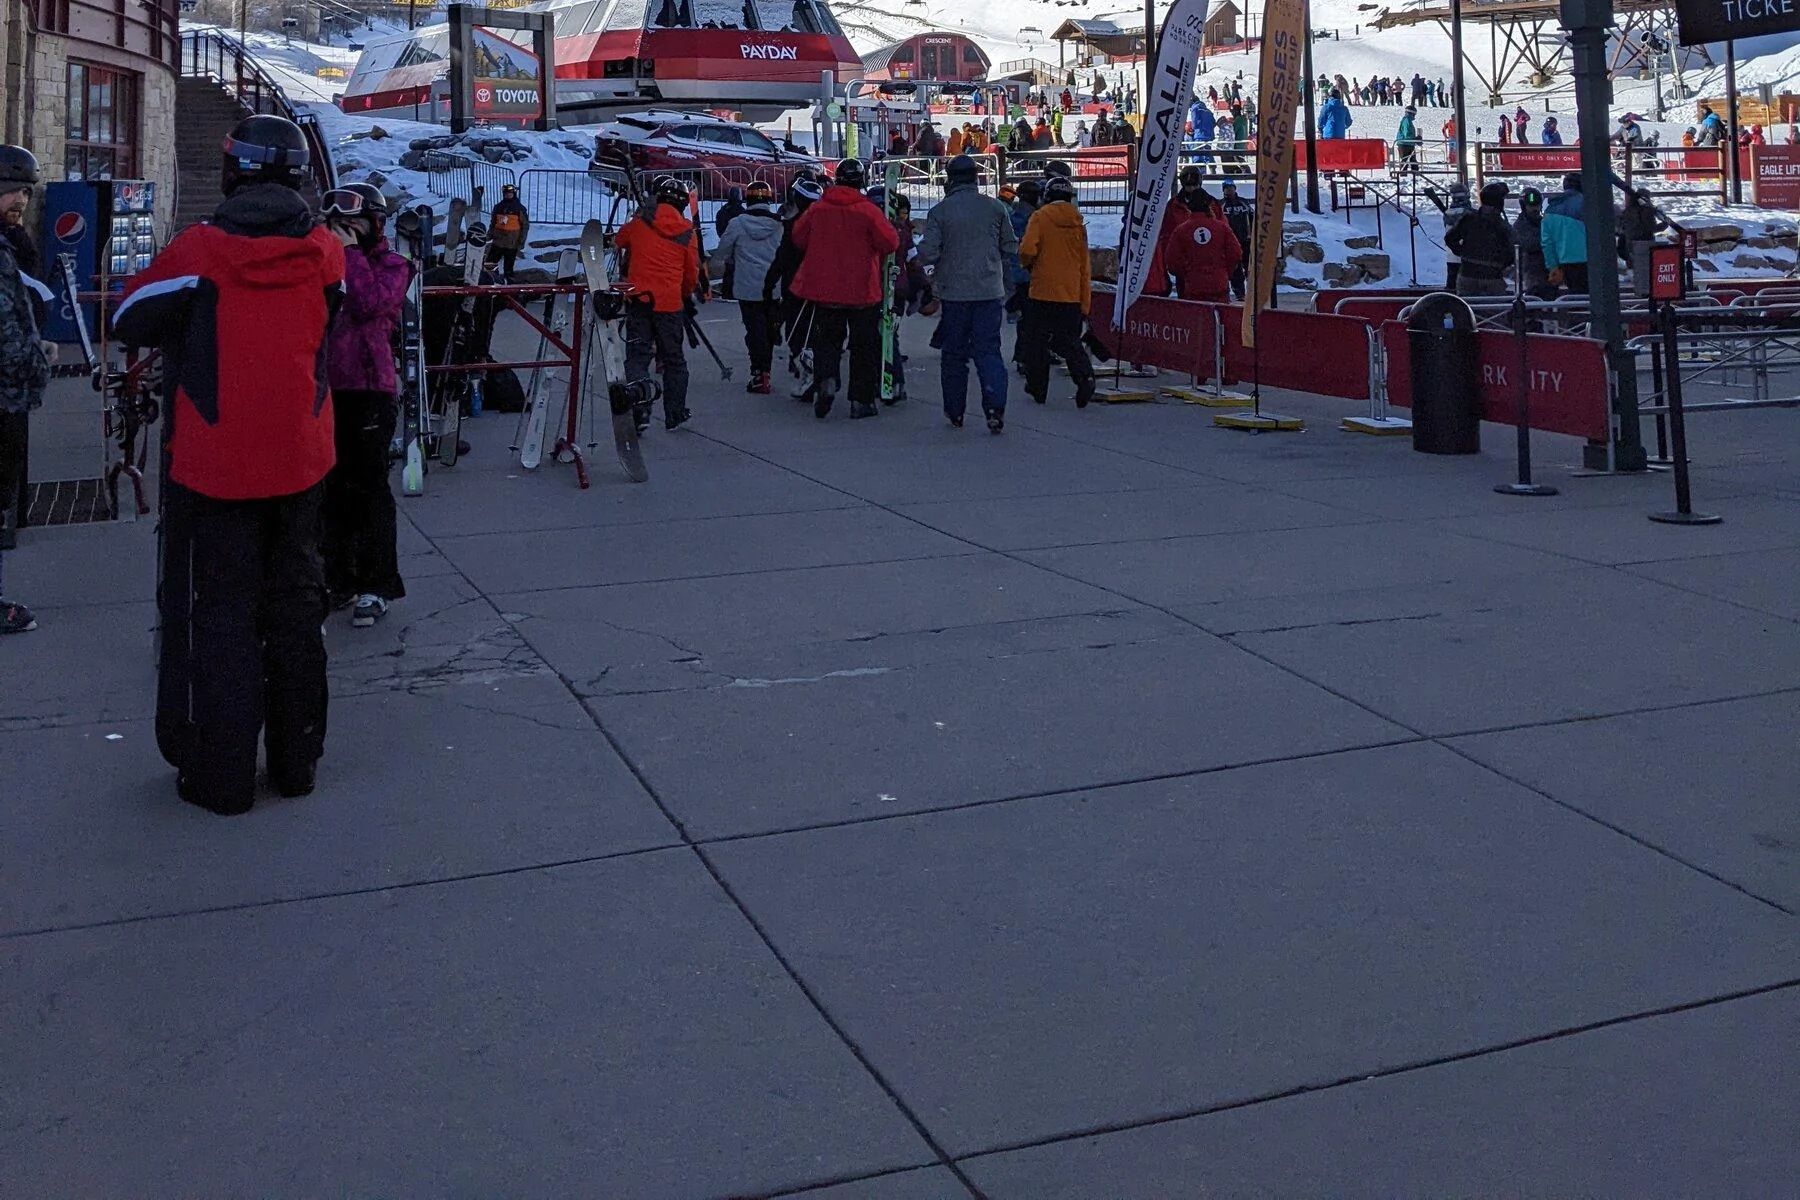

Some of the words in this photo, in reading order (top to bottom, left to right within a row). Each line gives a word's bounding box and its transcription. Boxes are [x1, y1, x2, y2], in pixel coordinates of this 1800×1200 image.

[1170, 23, 1187, 38] PARK
[740, 44, 797, 60] PAYDAY
[495, 89, 540, 104] TOYOTA
[1262, 30, 1288, 158] PASSES
[1273, 120, 1288, 164] AND
[1283, 34, 1298, 114] PICK-UP
[1146, 55, 1185, 165] CALL
[1128, 243, 1147, 294] COLLECT
[1142, 143, 1175, 240] PRE-PURCHASED
[1171, 93, 1185, 140] TICKETS
[1181, 62, 1190, 93] HERE
[1760, 164, 1783, 175] EAGLE
[1657, 273, 1676, 283] ONLY
[1659, 263, 1675, 273] EXIT
[1130, 320, 1160, 340] PARK
[1162, 325, 1191, 345] CITY
[1482, 364, 1508, 387] RK
[1530, 369, 1563, 393] ITY
